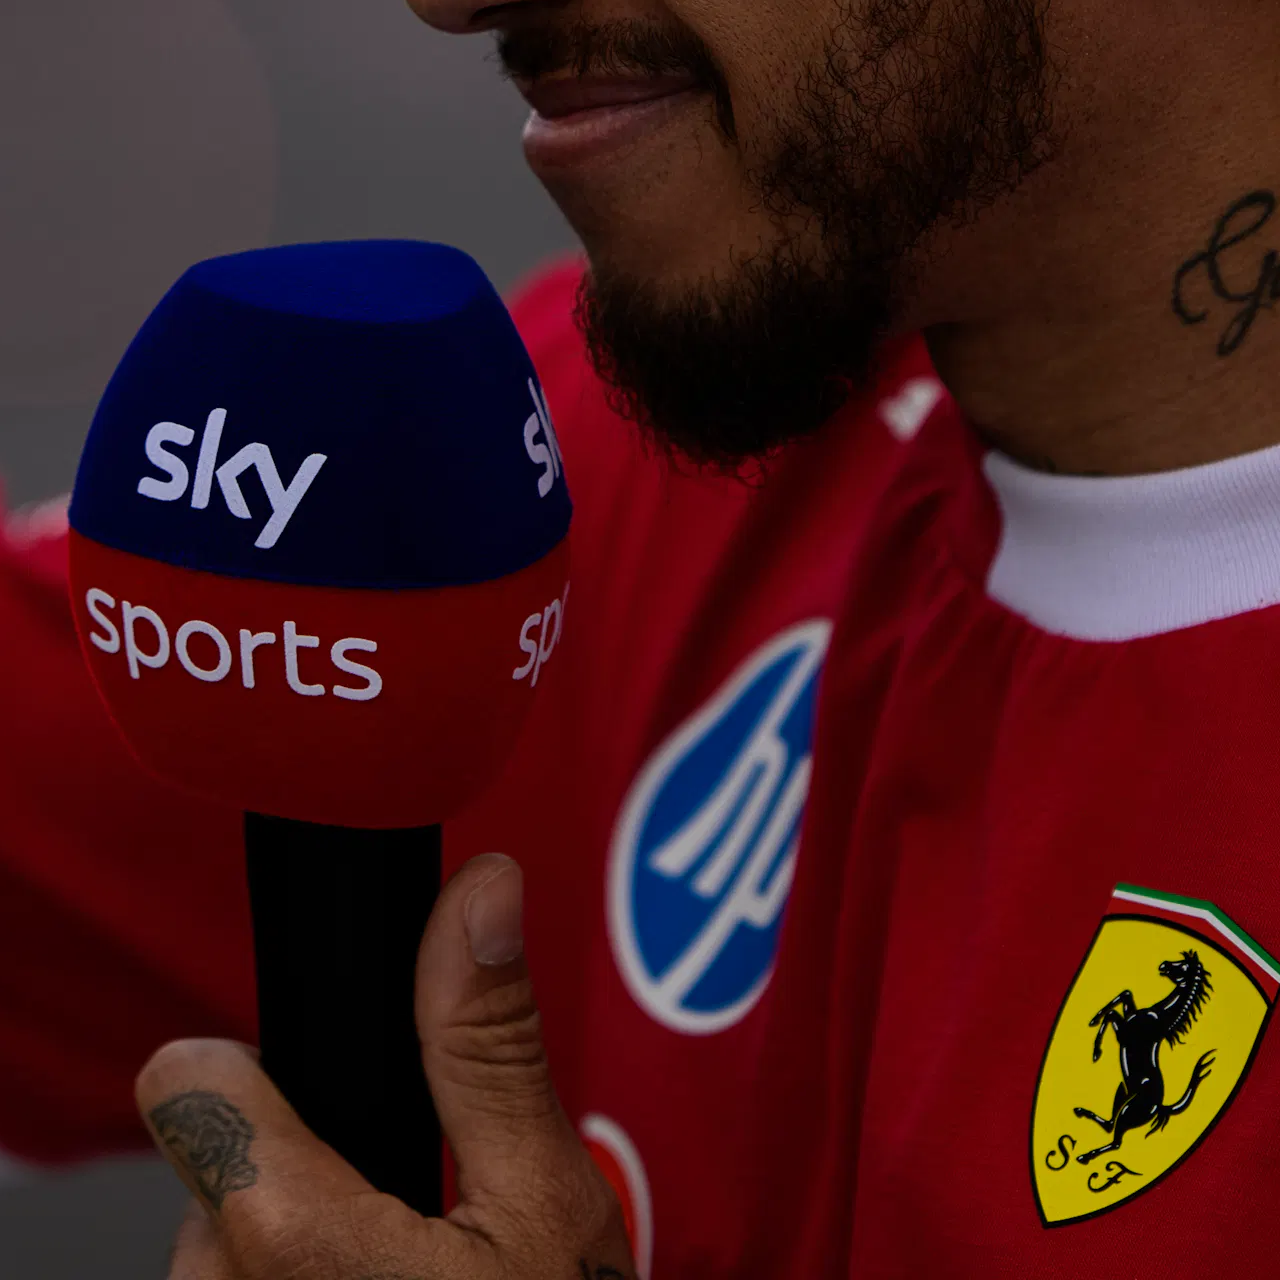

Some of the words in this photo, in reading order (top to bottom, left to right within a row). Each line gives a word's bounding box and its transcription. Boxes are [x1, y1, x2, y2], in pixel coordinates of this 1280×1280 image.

[136, 407, 328, 550] sky
[84, 587, 384, 702] sports
[646, 635, 817, 1007] hp
